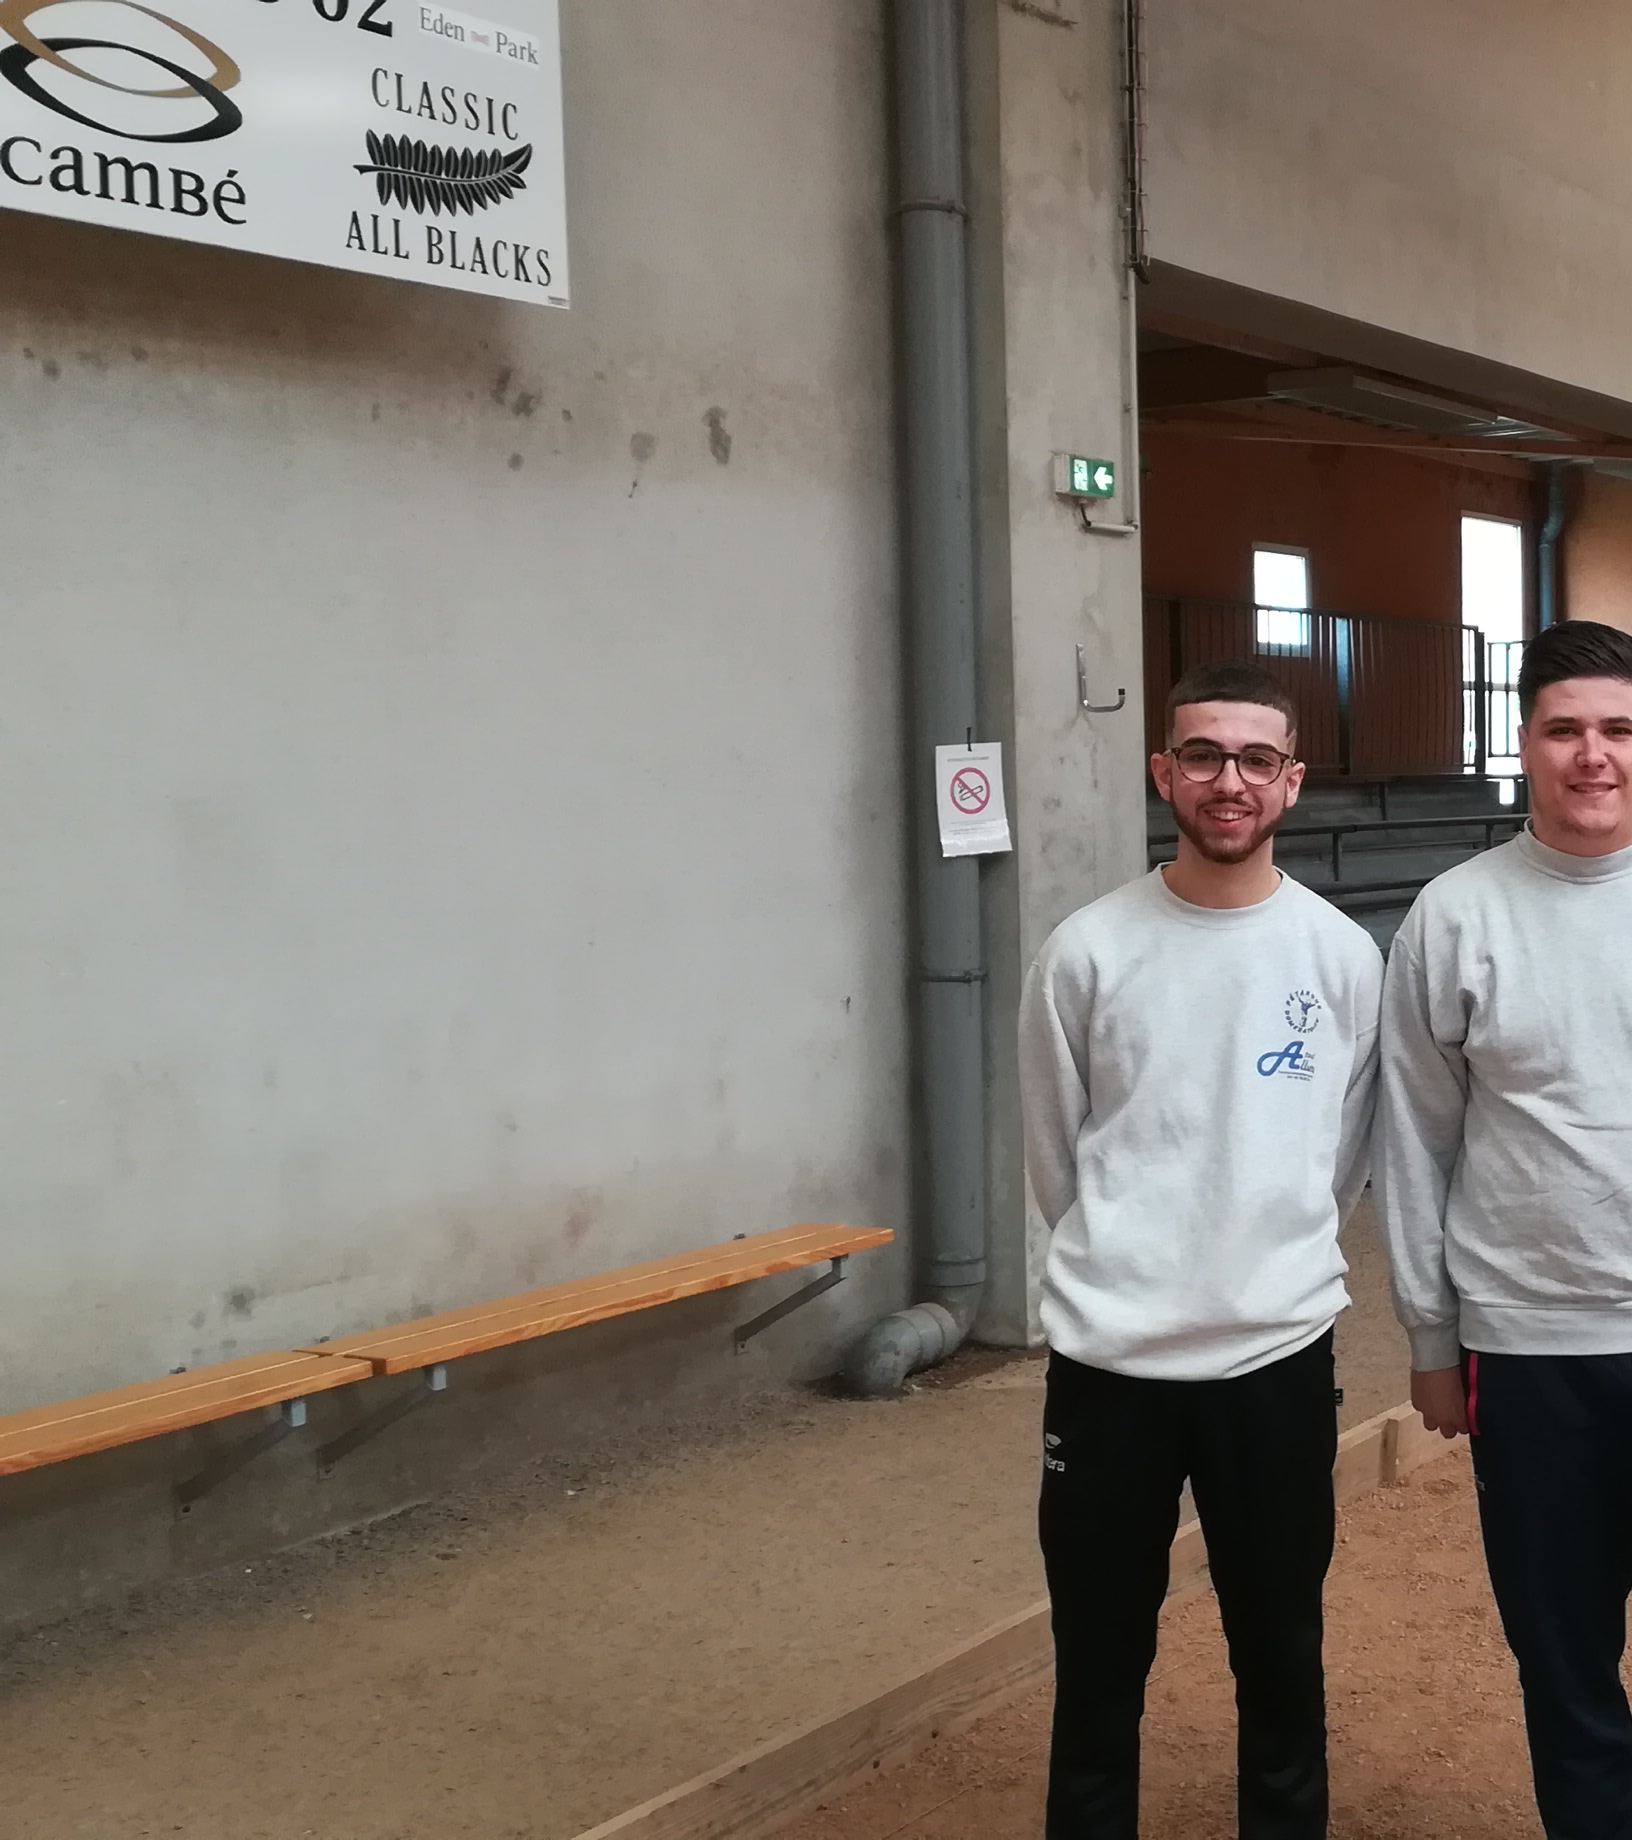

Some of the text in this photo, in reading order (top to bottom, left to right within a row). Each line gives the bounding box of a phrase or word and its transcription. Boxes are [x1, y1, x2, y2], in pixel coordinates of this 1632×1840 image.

[420, 6, 539, 65] Eden Park
[371, 67, 519, 141] CLASSIC
[345, 210, 552, 288] ALL BLACKS
